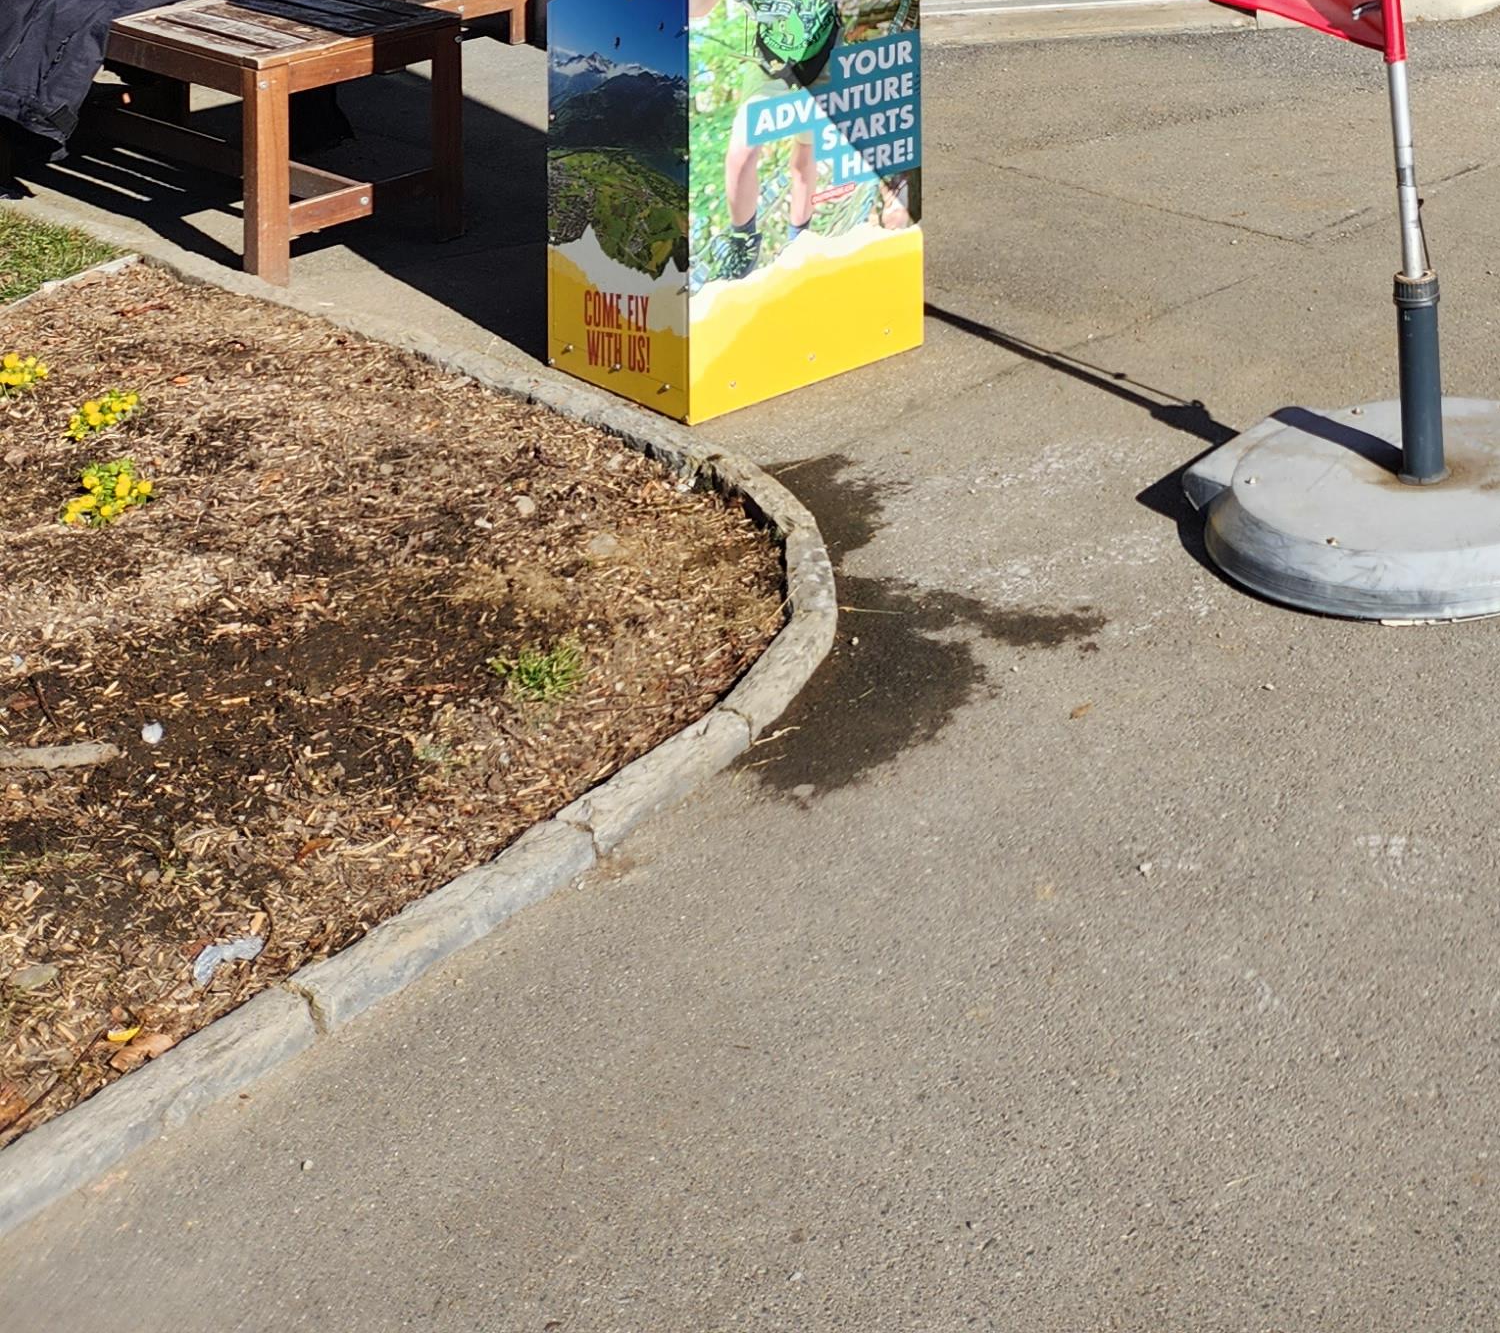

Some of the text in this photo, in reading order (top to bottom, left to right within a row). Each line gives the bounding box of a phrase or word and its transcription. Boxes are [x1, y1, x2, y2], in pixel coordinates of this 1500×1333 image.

[838, 40, 913, 79] YOUR
[754, 72, 913, 137] ADVENTURE
[821, 105, 914, 151] STARTS
[841, 137, 914, 179] HERE!
[584, 290, 649, 333] COME FLY
[587, 329, 650, 373] WITH US!
